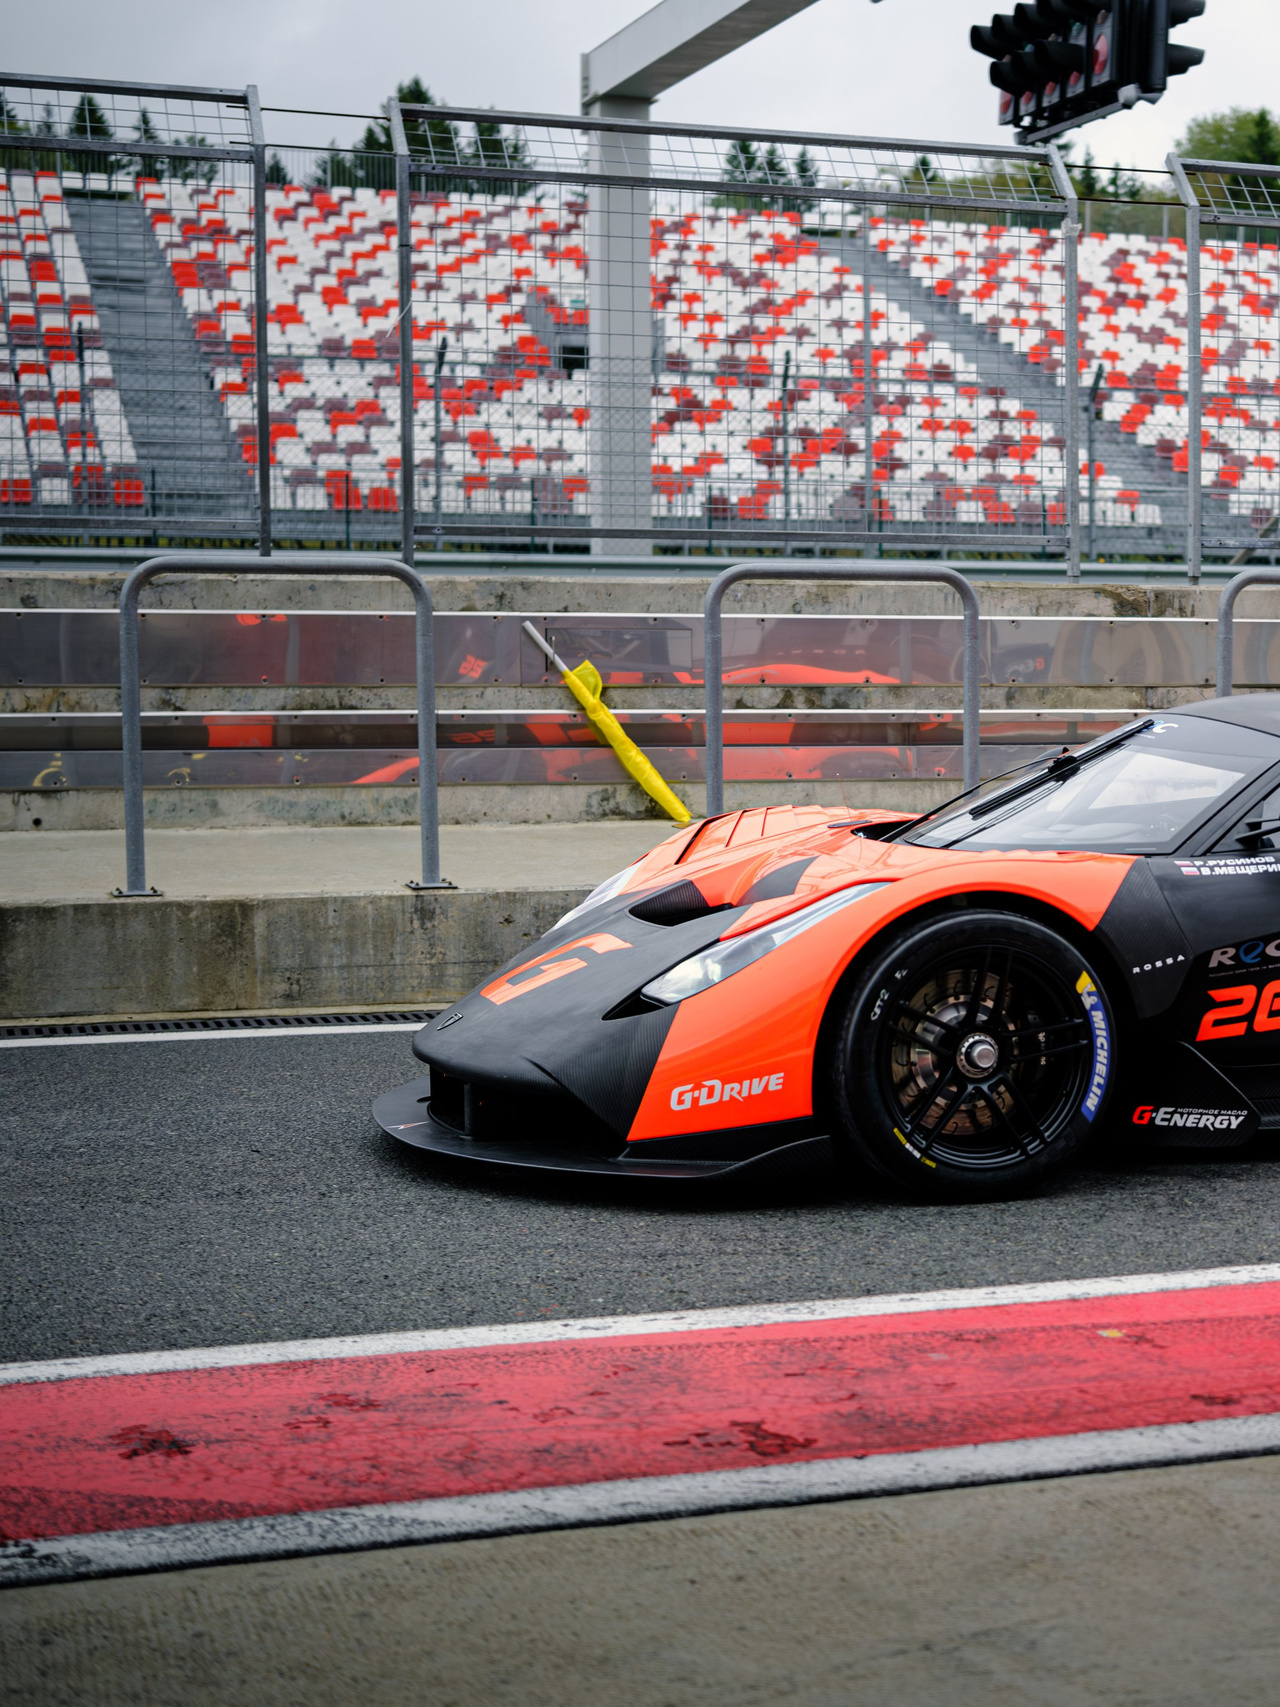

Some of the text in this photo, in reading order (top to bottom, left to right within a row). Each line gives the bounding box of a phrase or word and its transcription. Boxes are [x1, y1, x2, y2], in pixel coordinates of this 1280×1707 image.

[1193, 856, 1275, 867] Р.РУСИНОВ
[1132, 954, 1186, 974] ROSSA
[1086, 1010, 1108, 1112] MICHELIN
[1176, 1107, 1220, 1115] МОТОРНОЕ
